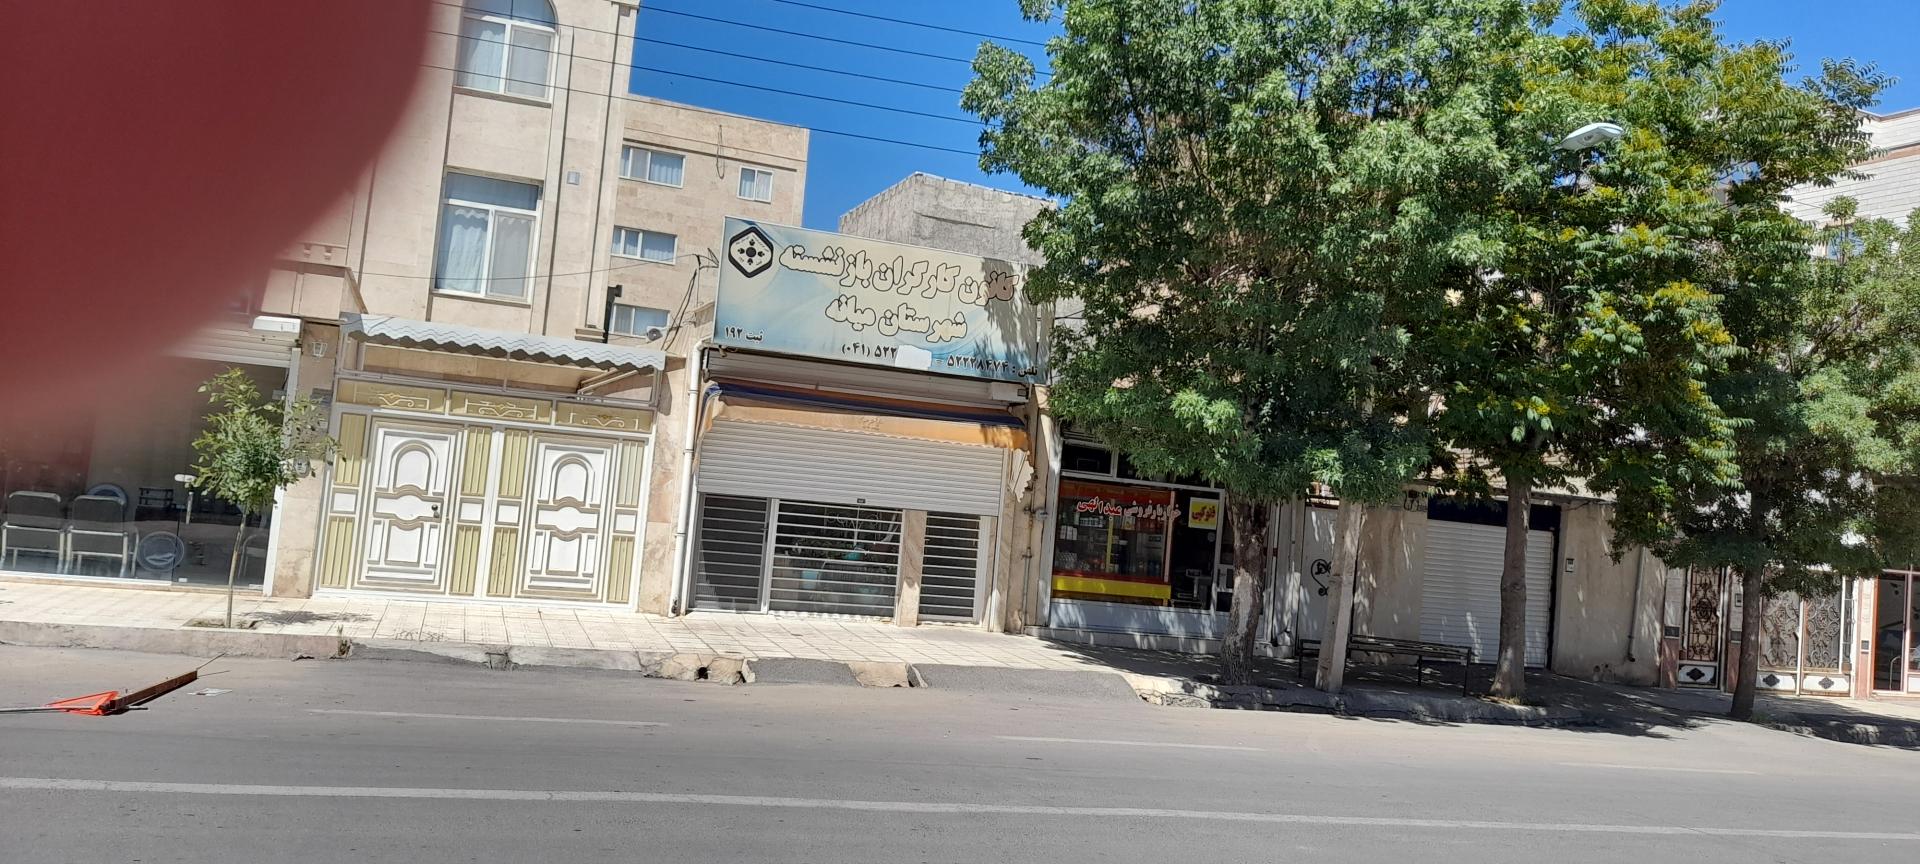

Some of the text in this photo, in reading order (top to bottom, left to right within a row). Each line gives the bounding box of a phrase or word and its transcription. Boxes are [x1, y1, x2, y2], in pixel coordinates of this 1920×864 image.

[958, 270, 1019, 306] کانون
[745, 330, 764, 344] ثبت
[878, 302, 968, 343] شهرستان
